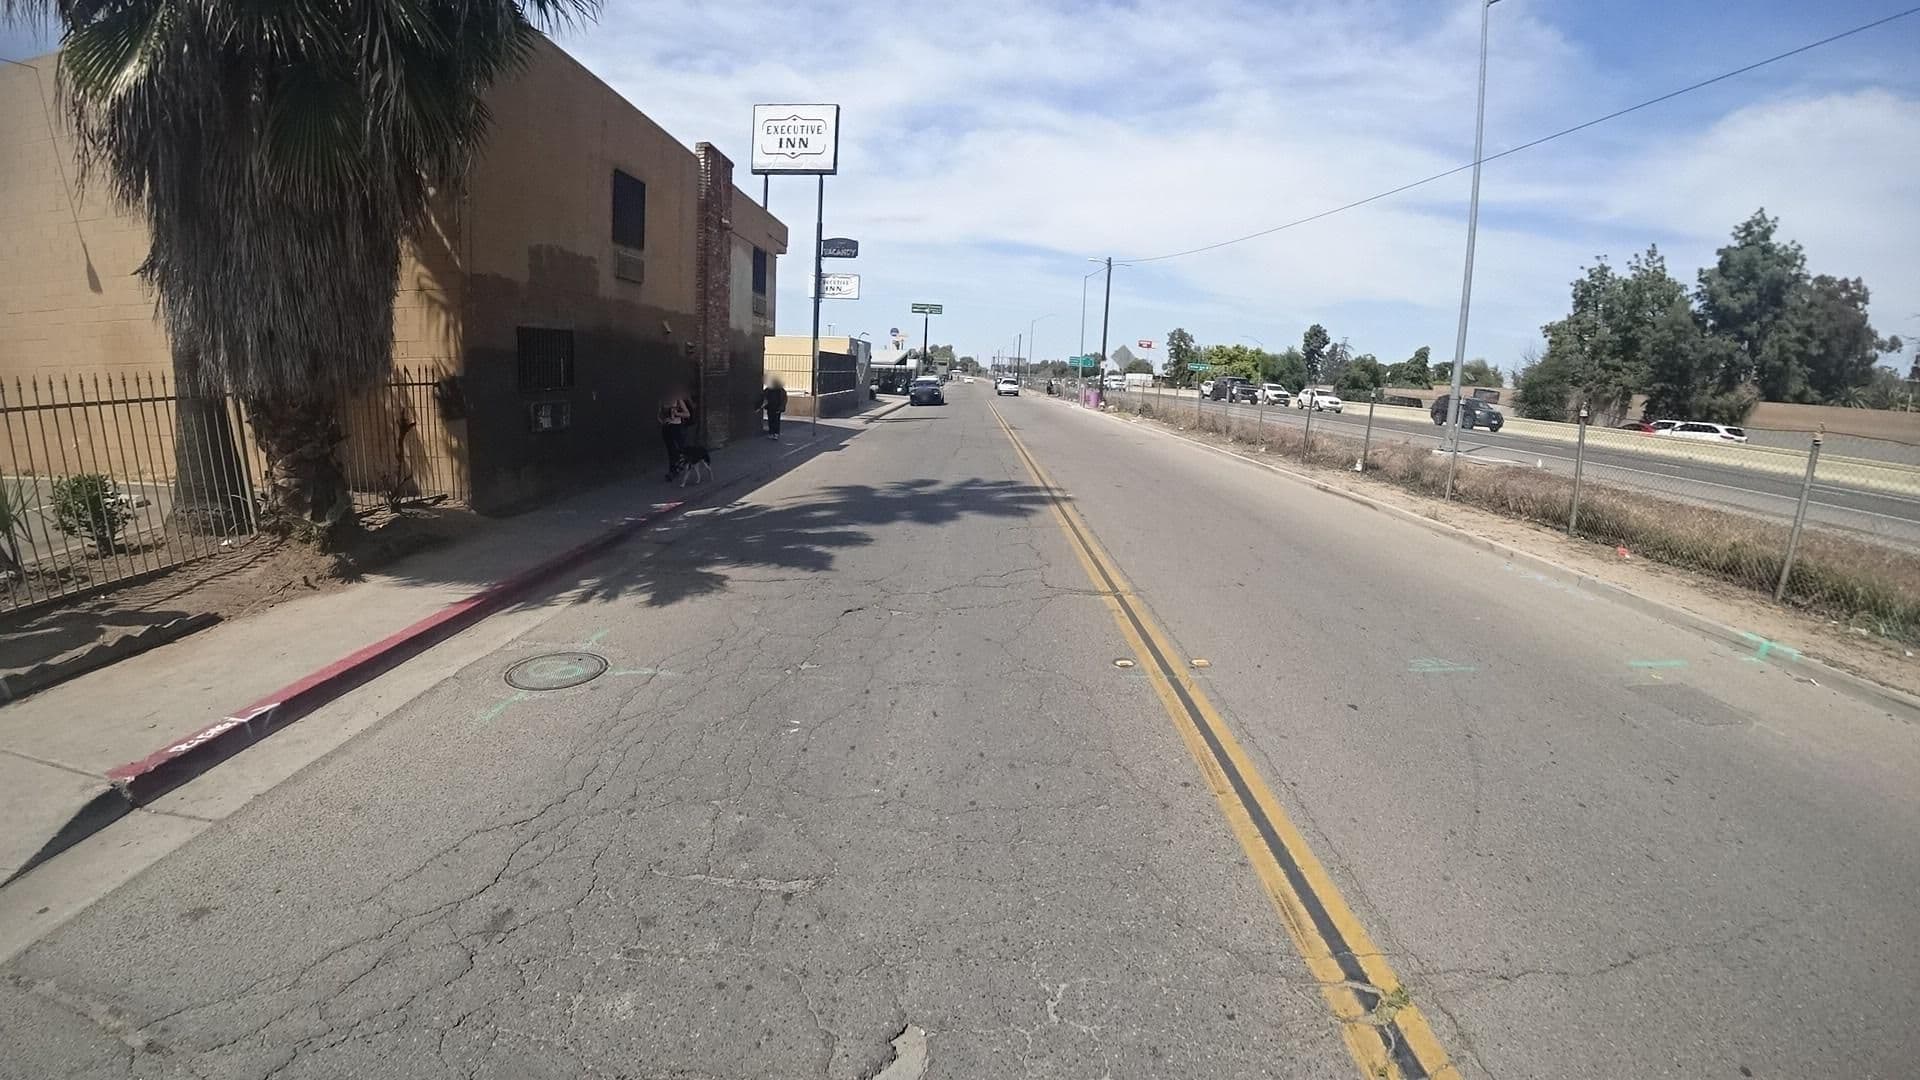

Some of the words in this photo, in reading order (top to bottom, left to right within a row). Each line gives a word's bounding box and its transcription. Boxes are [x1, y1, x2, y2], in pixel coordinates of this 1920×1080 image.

[766, 125, 823, 134] EXECUTIVE
[779, 137, 808, 148] INN
[823, 247, 856, 256] VACANCY
